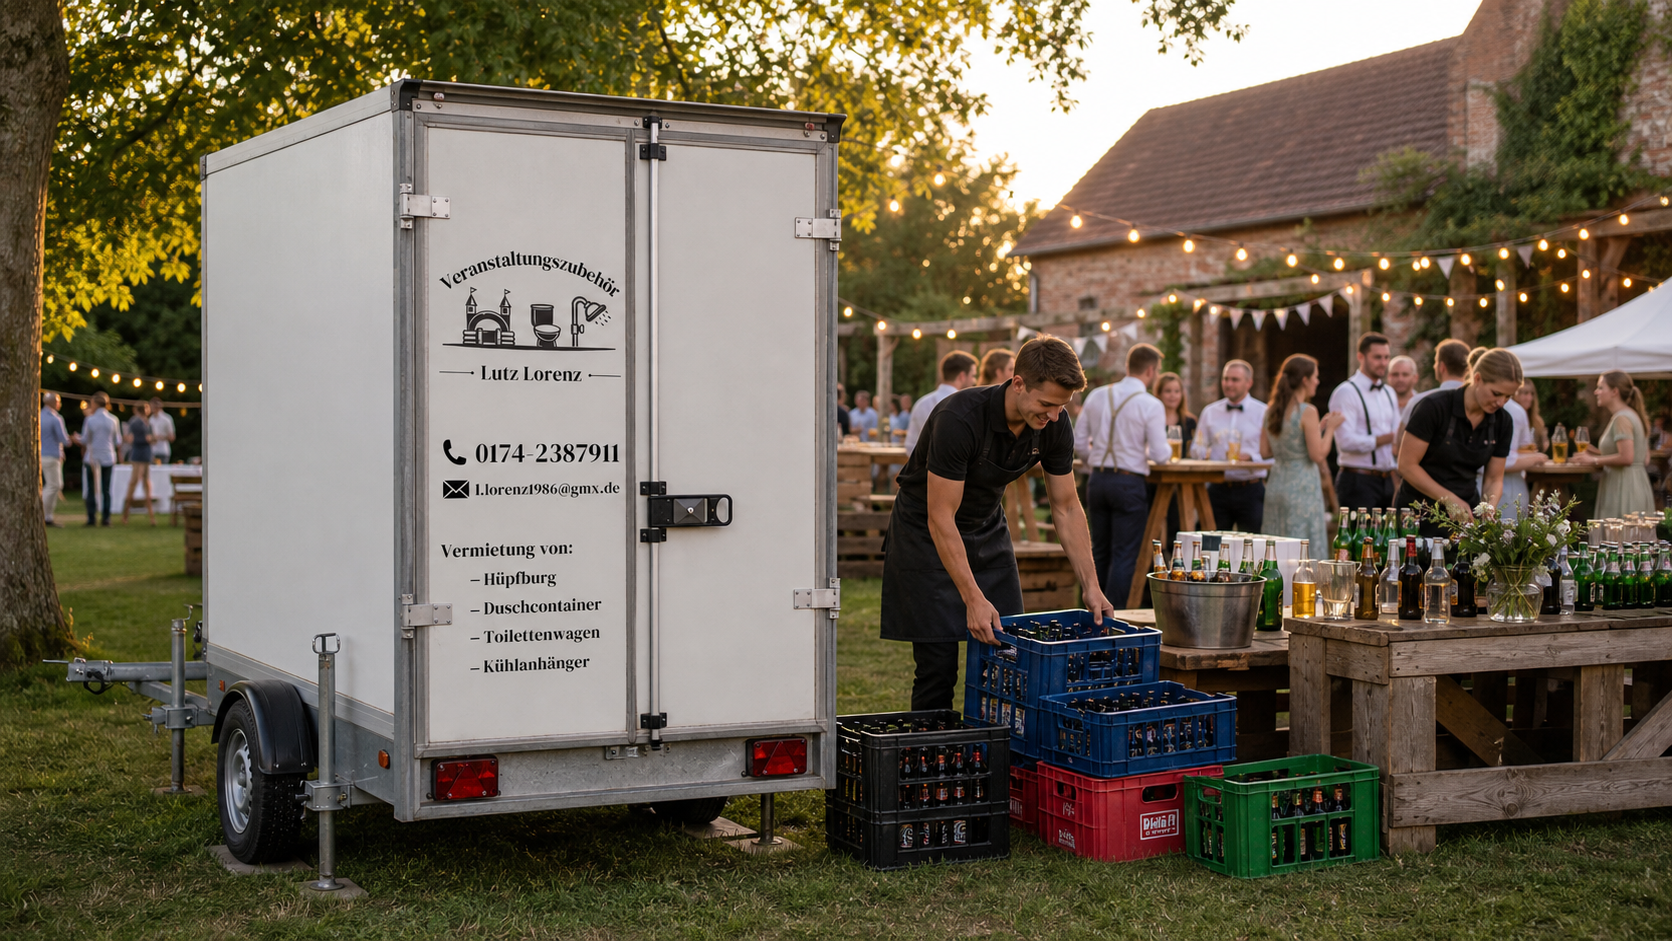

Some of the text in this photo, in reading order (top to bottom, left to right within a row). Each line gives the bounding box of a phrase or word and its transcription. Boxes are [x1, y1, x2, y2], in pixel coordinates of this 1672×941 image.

[439, 251, 620, 297] Veranstaltungszubehör
[481, 365, 583, 382] Lutz Lorenz
[475, 443, 620, 463] 0174-2387911
[475, 482, 620, 498] l.lorenz1986@gmx.de
[441, 543, 573, 559] Vermietung von:
[484, 571, 557, 588] Hüpfburg
[484, 598, 602, 615] Duschcontainer
[484, 628, 601, 643] Toilettenwagen
[484, 656, 590, 673] Kühlanhänger
